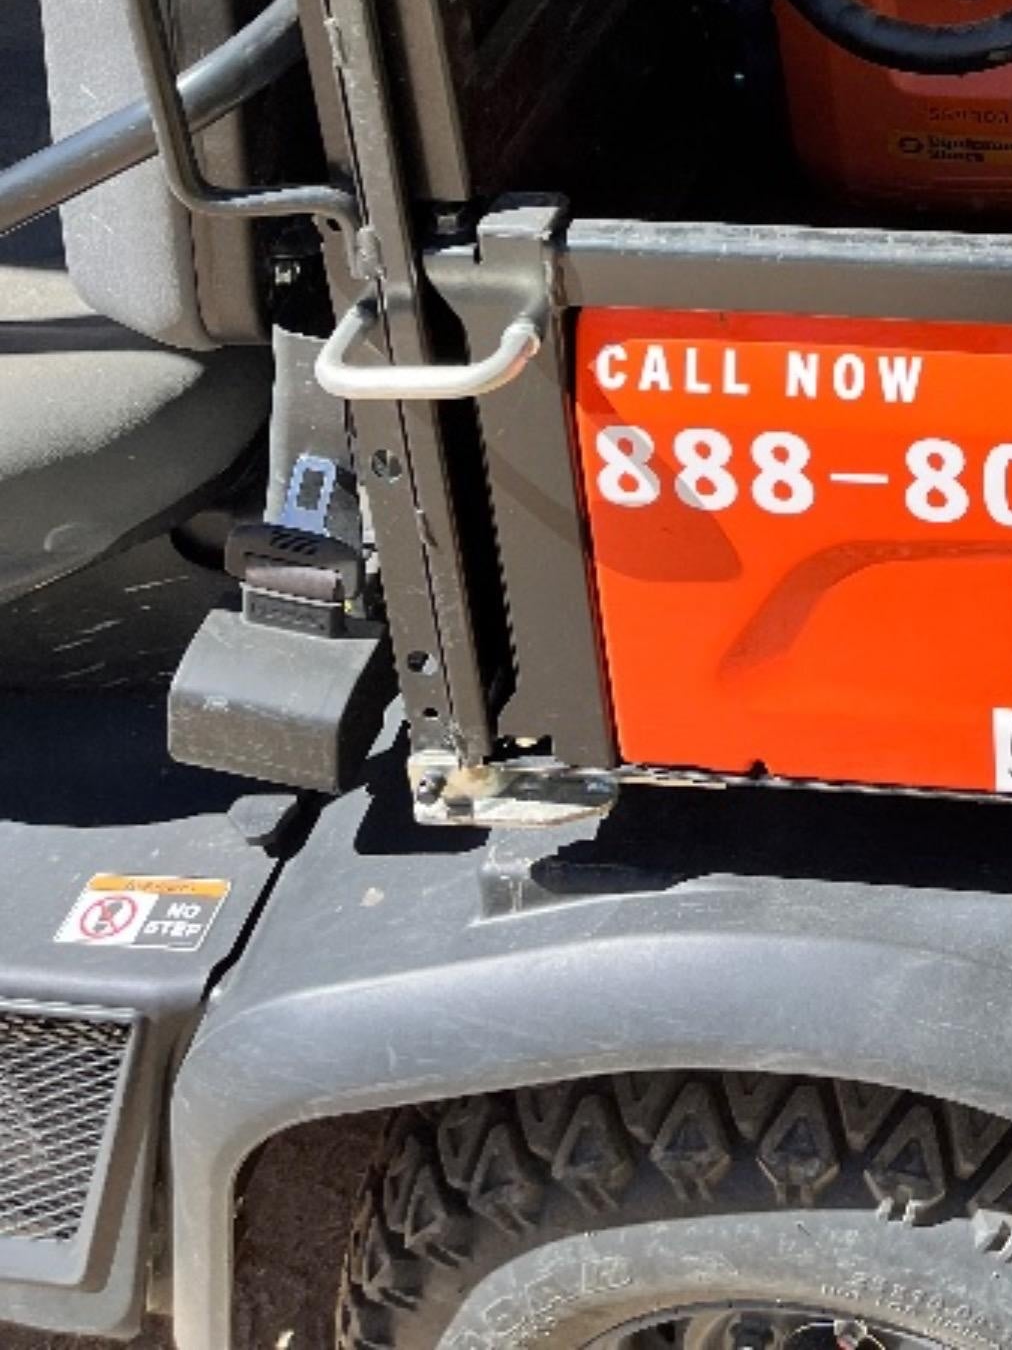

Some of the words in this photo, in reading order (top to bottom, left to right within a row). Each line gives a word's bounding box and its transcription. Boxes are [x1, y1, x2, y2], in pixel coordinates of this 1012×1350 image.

[595, 343, 750, 395] CALL
[786, 352, 923, 403] NOW
[166, 901, 202, 920] NO
[143, 919, 203, 938] STEP
